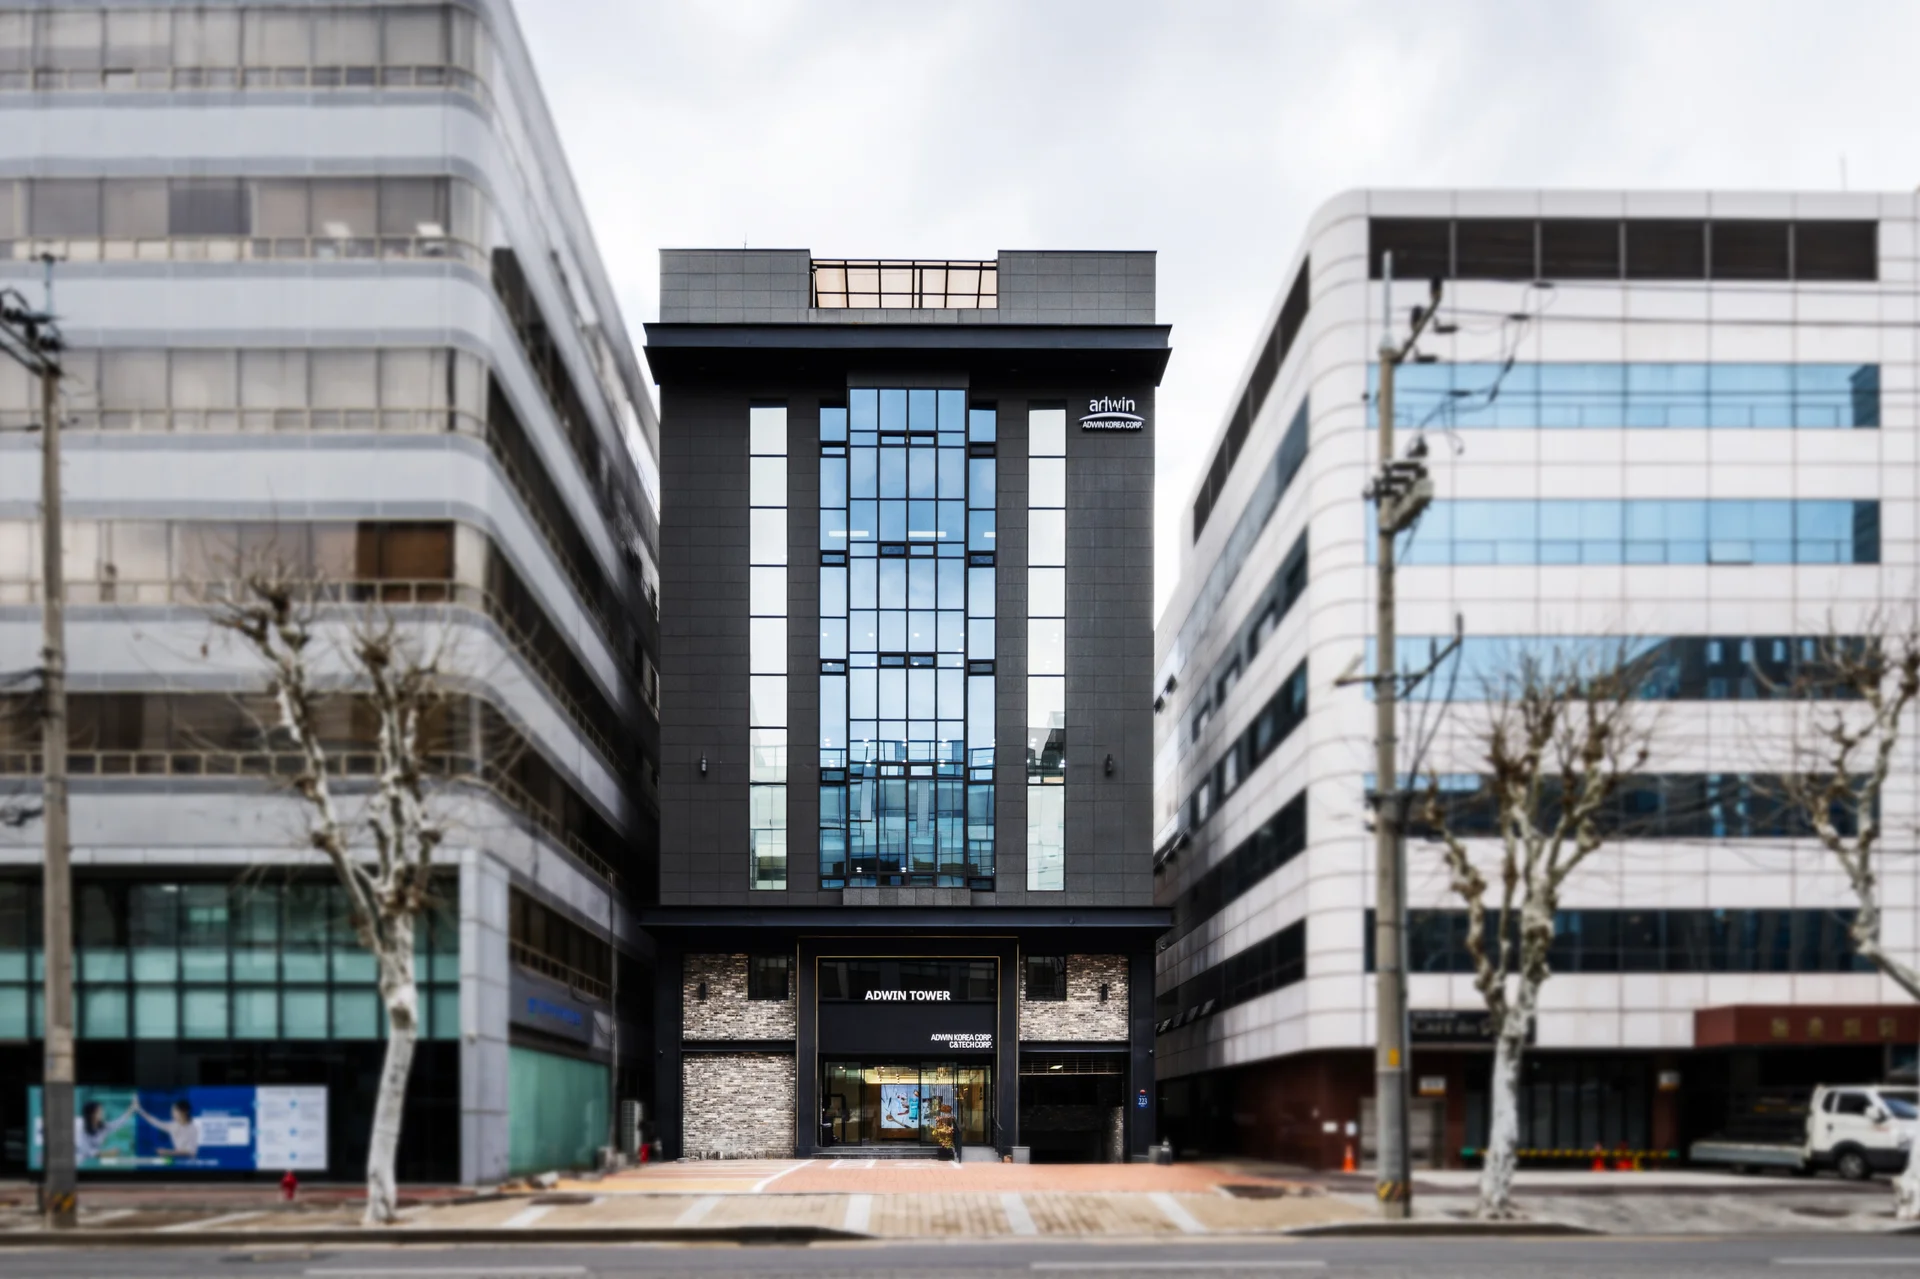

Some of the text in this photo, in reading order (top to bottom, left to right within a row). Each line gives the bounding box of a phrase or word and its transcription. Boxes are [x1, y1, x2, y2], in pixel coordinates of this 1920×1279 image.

[1089, 396, 1136, 412] adwin
[1082, 421, 1144, 429] ADWIN KOREA CORP.
[865, 990, 951, 1001] ADWIN TOWER
[931, 1034, 993, 1042] ADWIN KOREA CORP.
